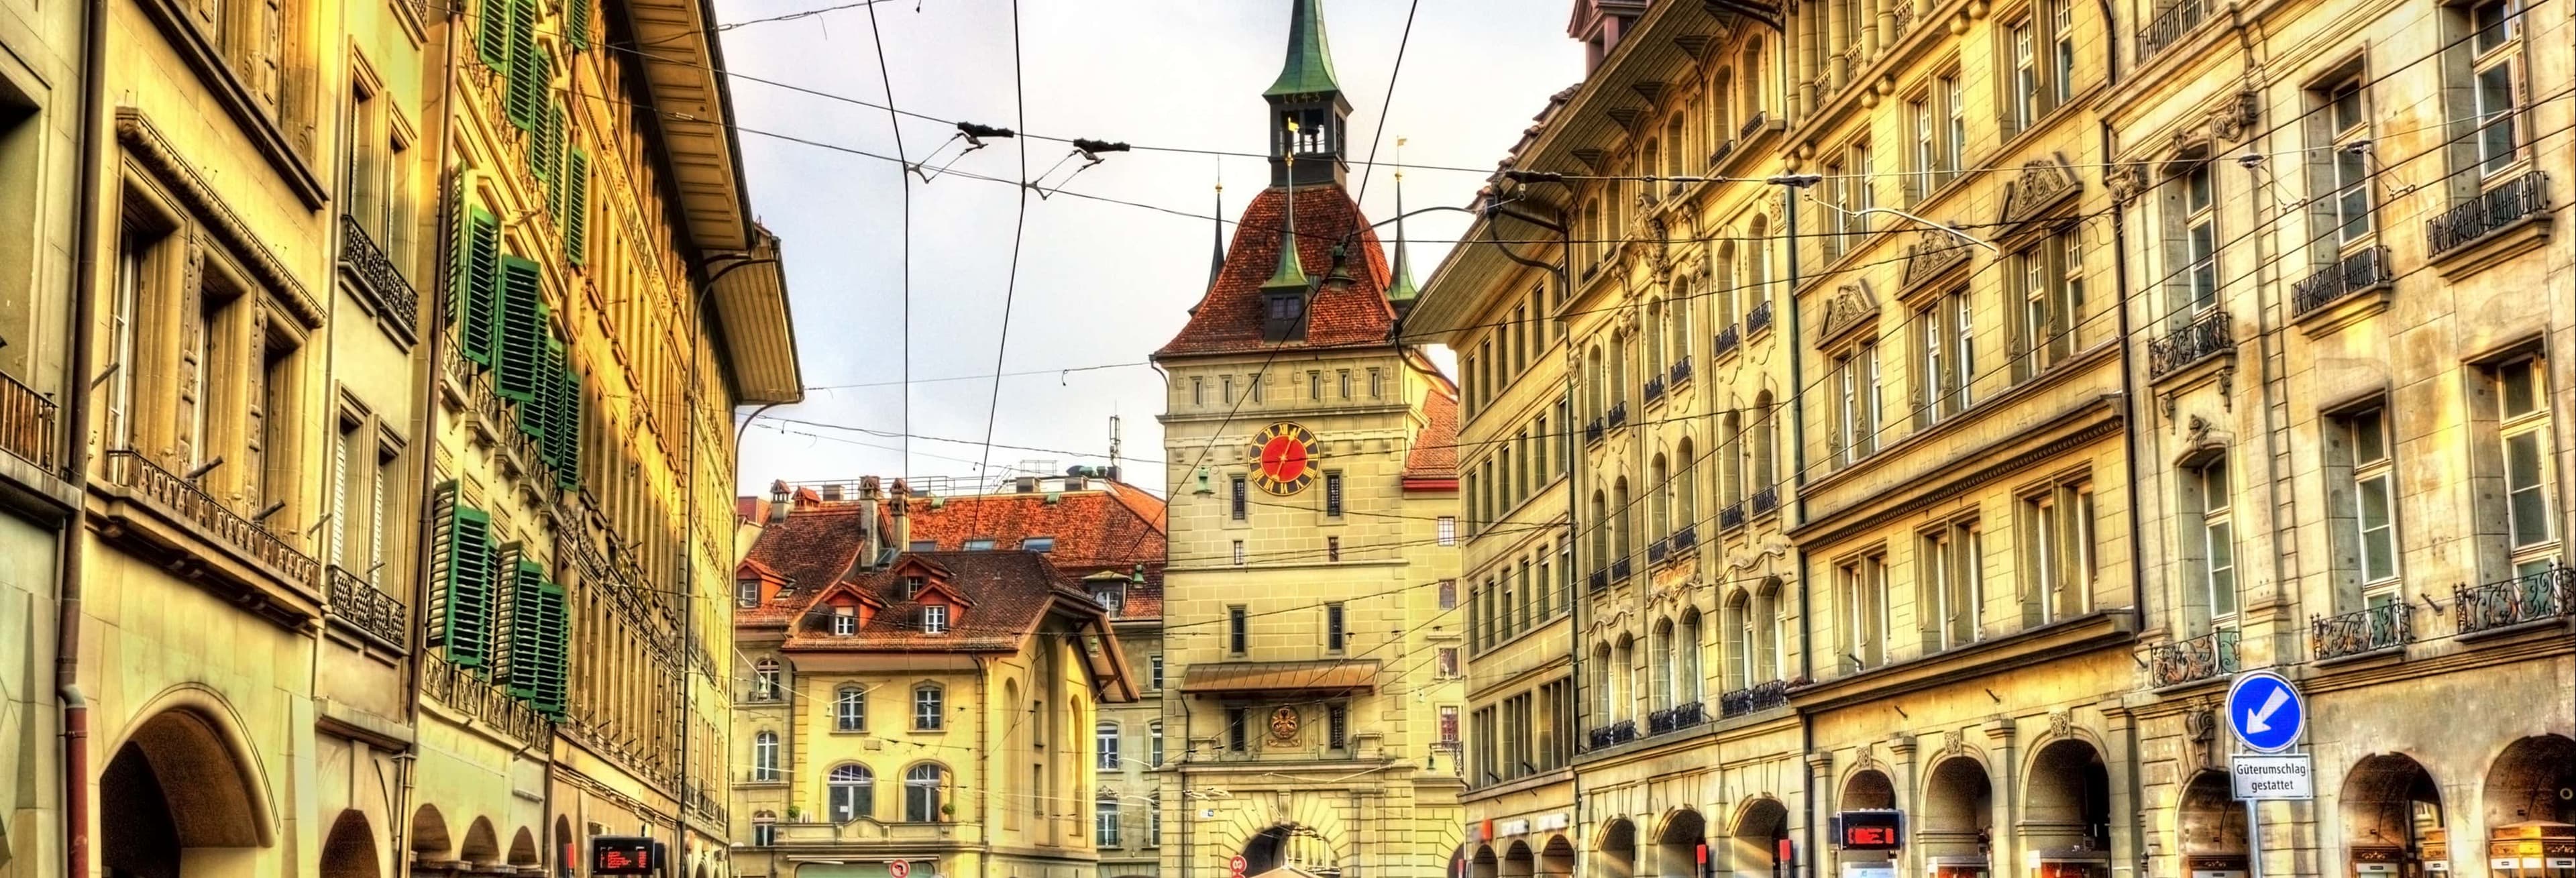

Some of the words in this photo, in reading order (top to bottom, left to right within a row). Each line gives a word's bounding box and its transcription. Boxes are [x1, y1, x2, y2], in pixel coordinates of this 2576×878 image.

[1279, 424, 1288, 436] XII
[1253, 441, 1265, 450] X
[2237, 763, 2306, 777] Güterumschlag
[2251, 781, 2294, 793] gestattet
